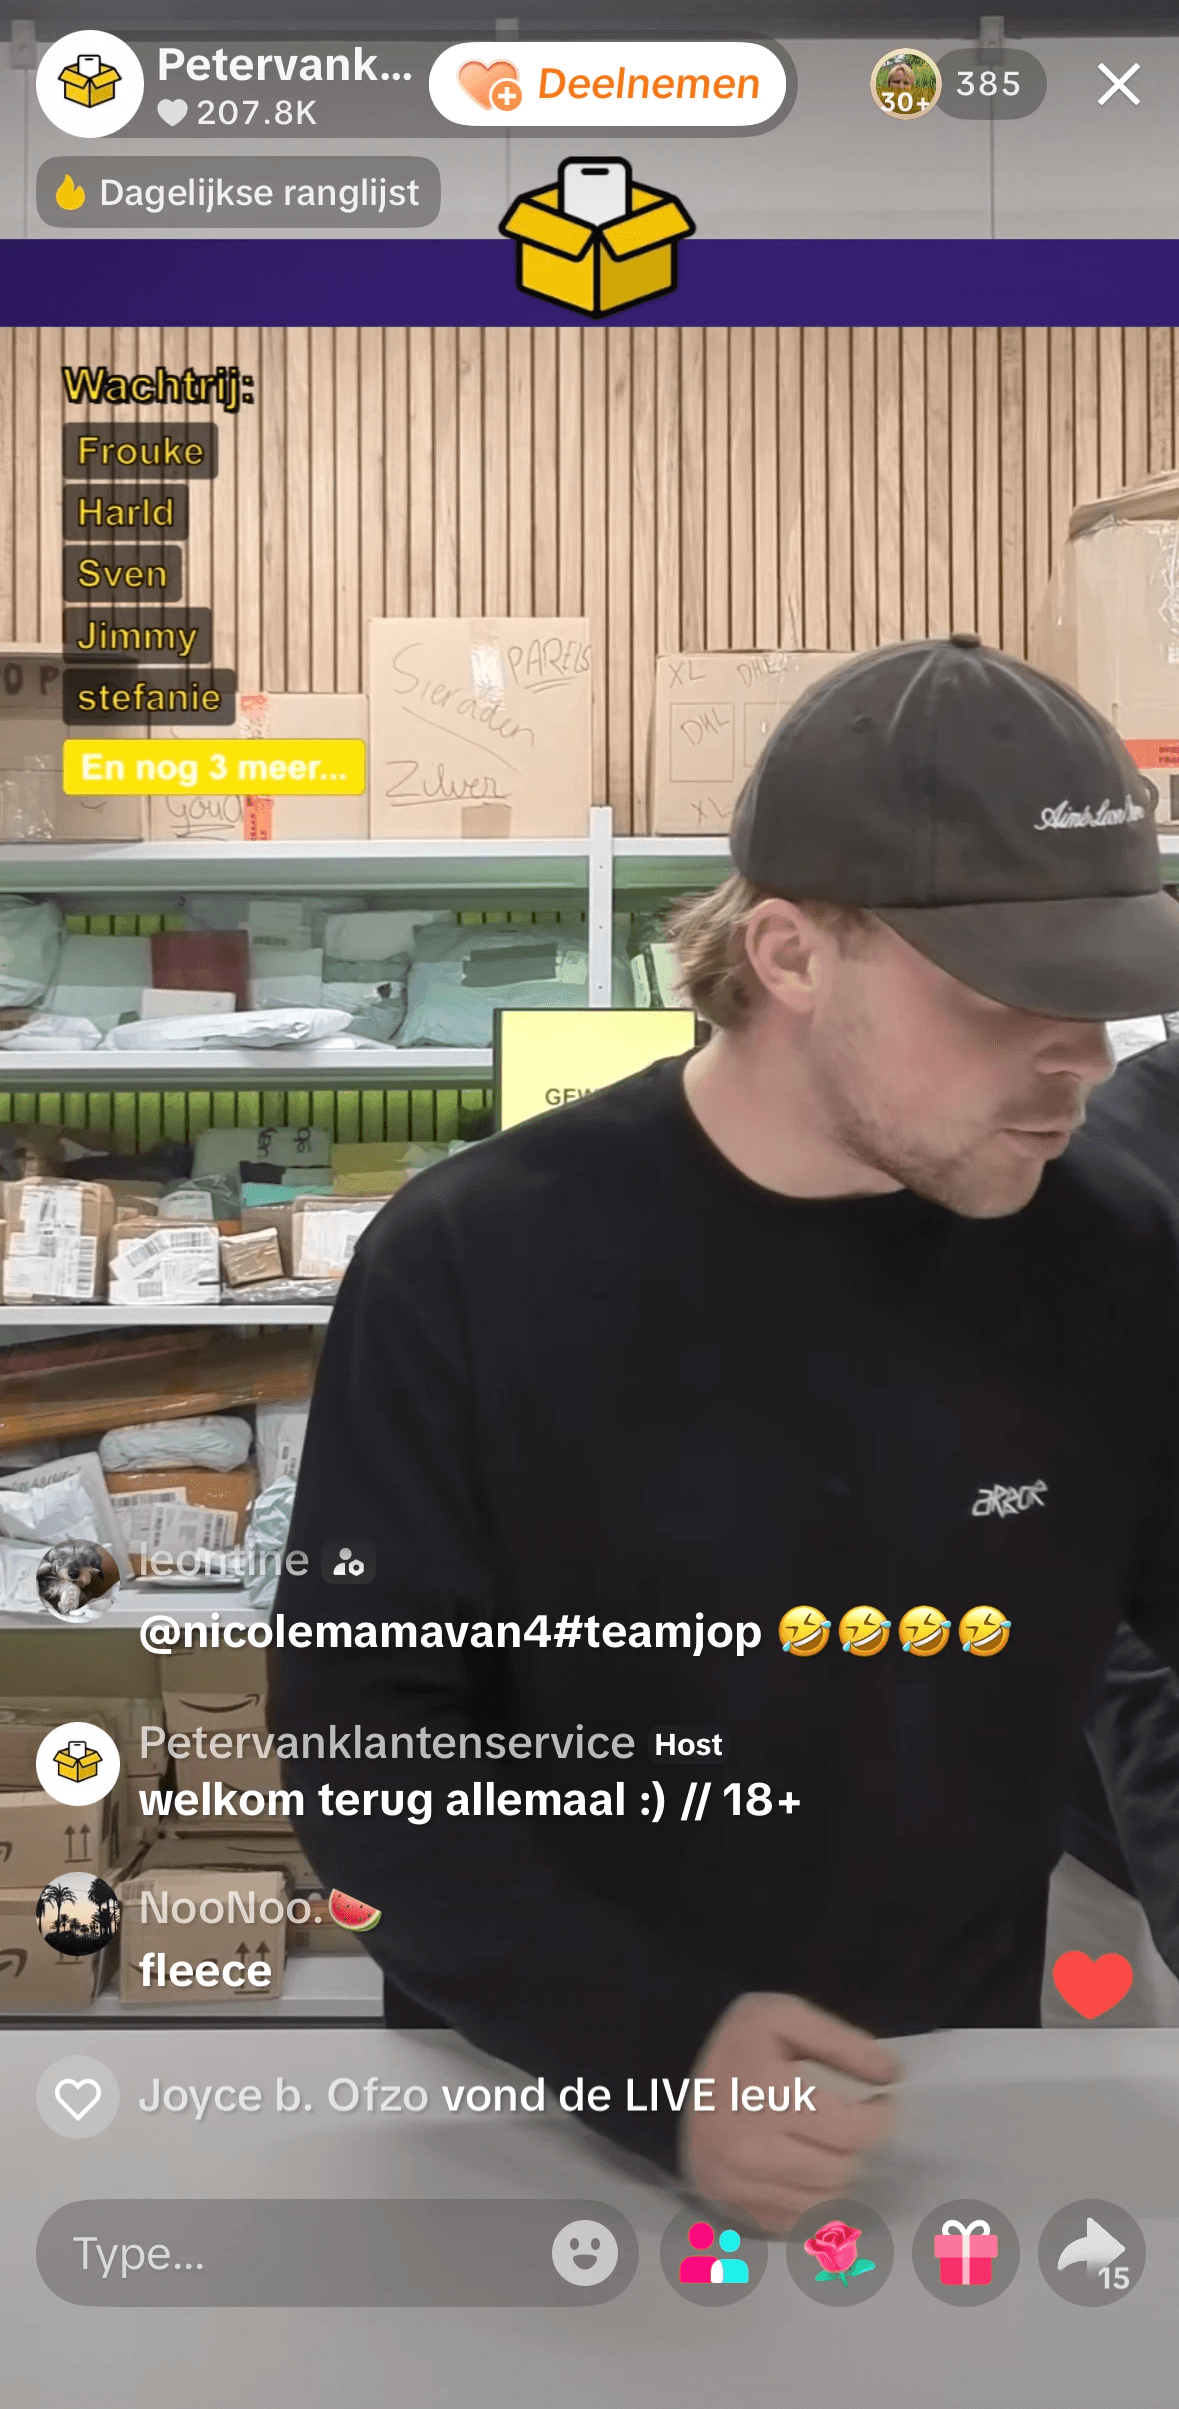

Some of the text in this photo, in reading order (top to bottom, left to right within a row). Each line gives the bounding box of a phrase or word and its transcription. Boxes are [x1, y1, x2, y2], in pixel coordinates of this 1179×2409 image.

[669, 659, 707, 689] XL
[680, 706, 732, 746] DHL
[385, 760, 514, 799] Zilver
